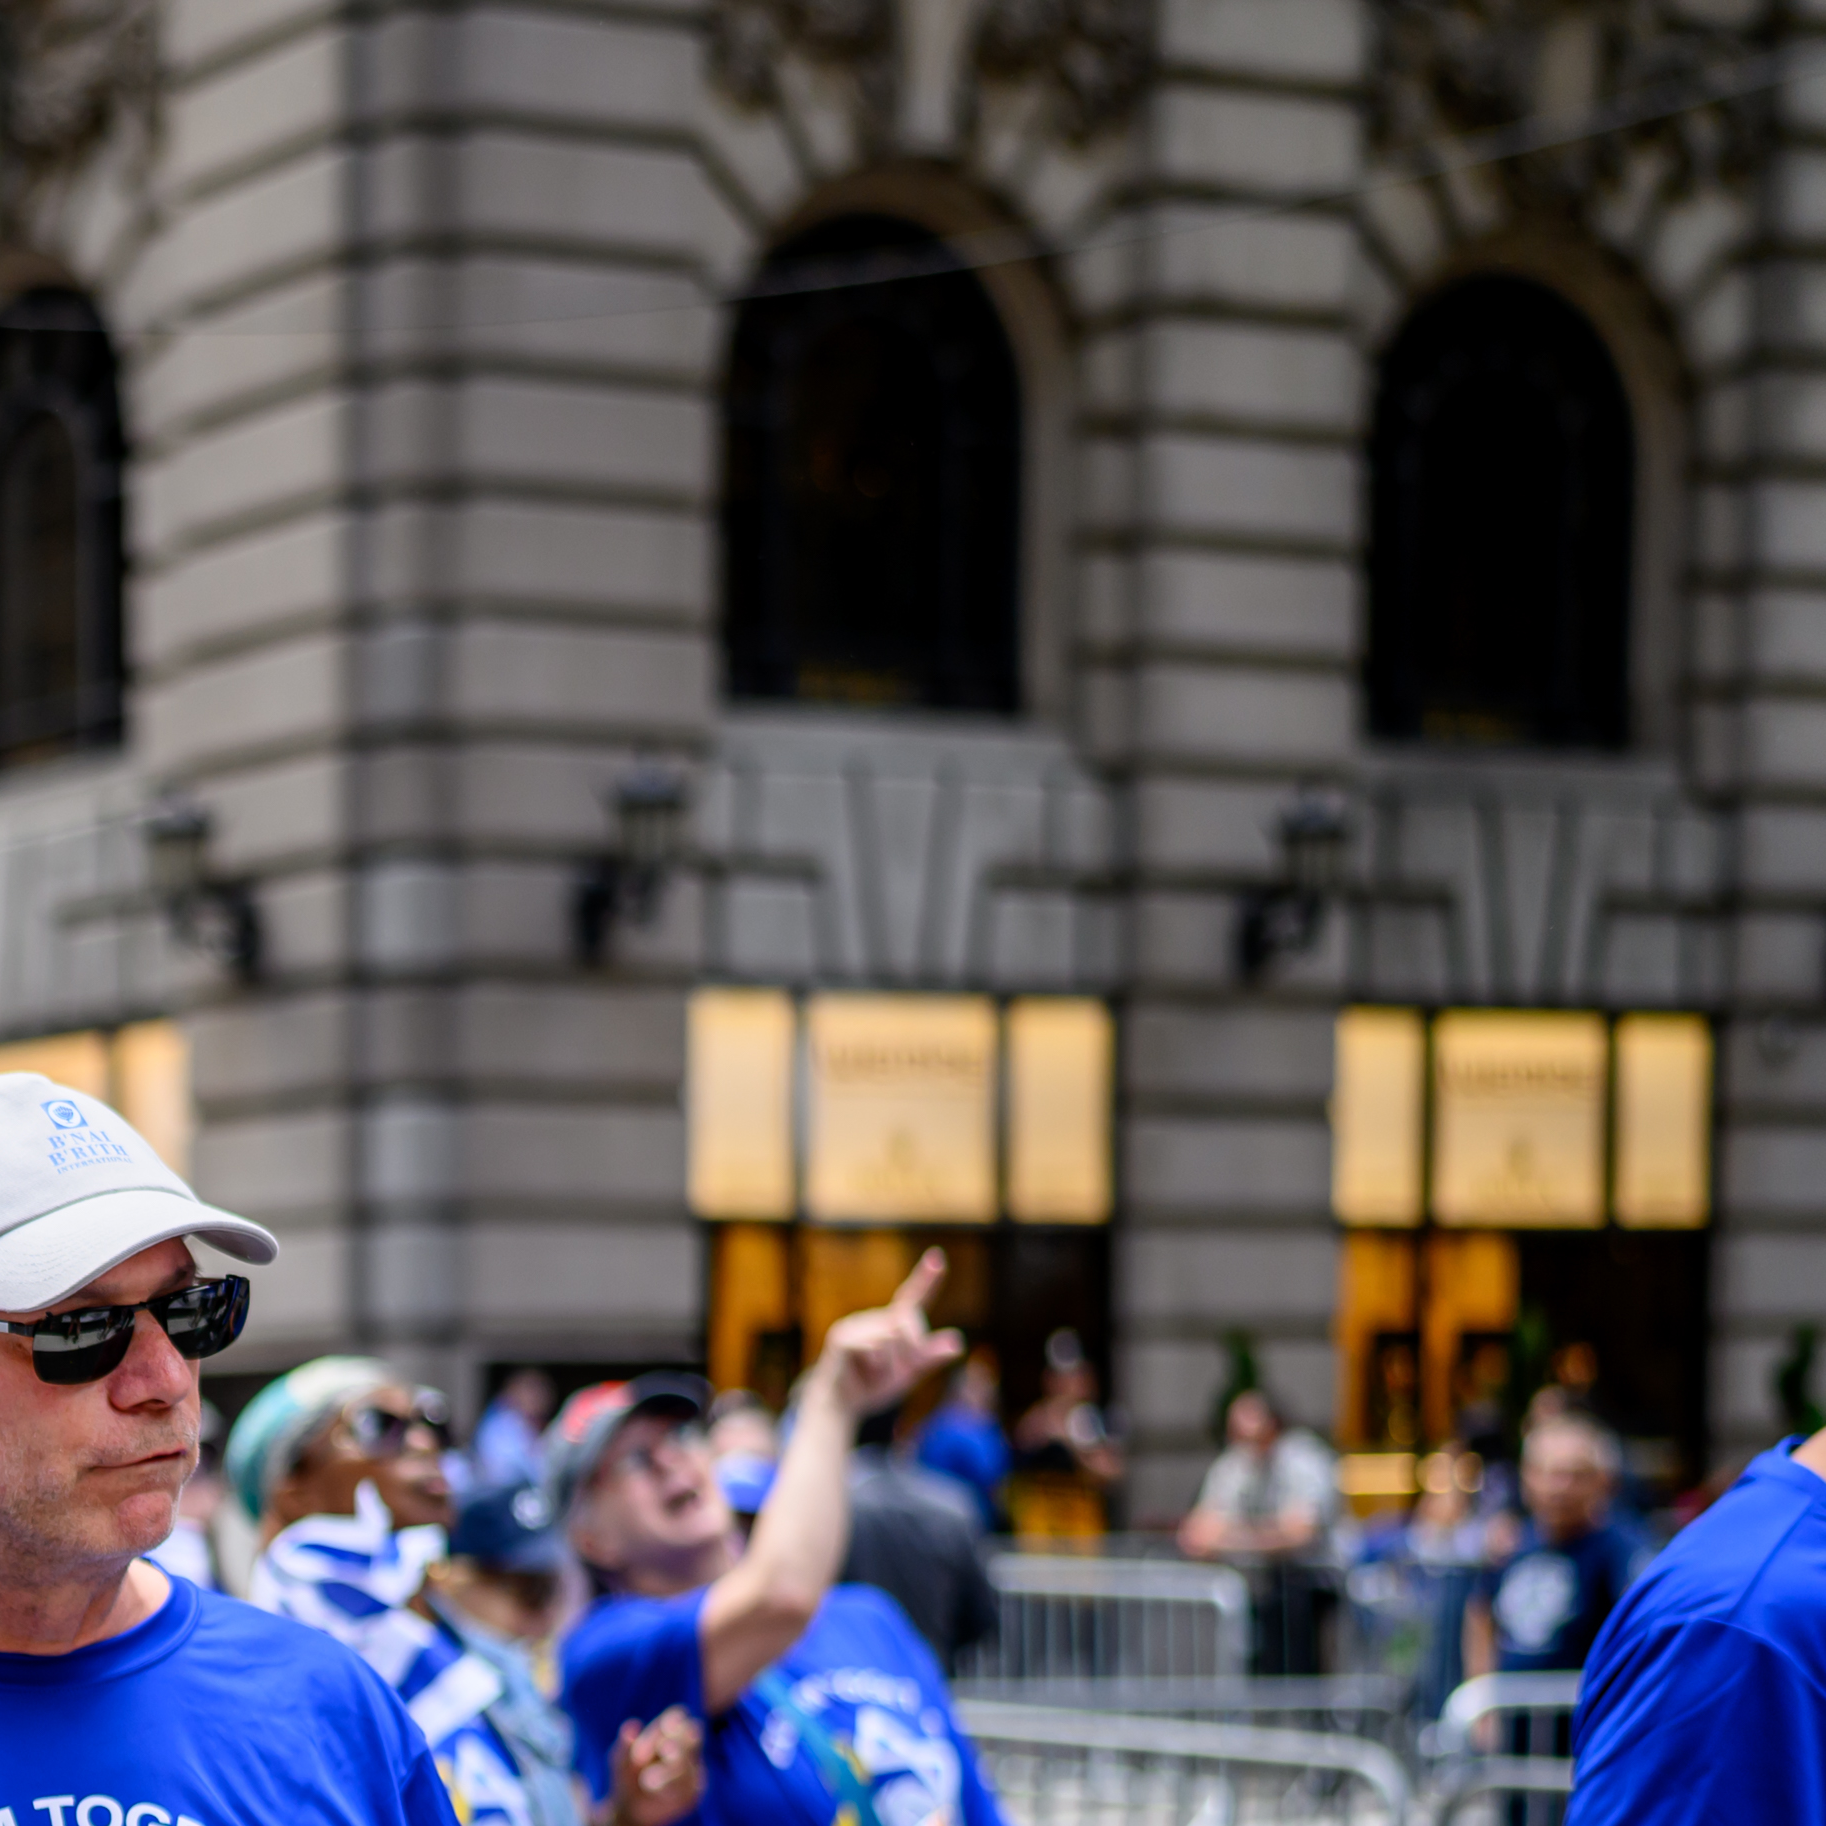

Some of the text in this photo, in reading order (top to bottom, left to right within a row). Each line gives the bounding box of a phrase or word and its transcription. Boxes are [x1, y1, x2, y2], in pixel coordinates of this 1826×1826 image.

[48, 1131, 111, 1149] B'NAI
[48, 1144, 129, 1167] B'RITH
[57, 1156, 133, 1175] INTERNATIONAL
